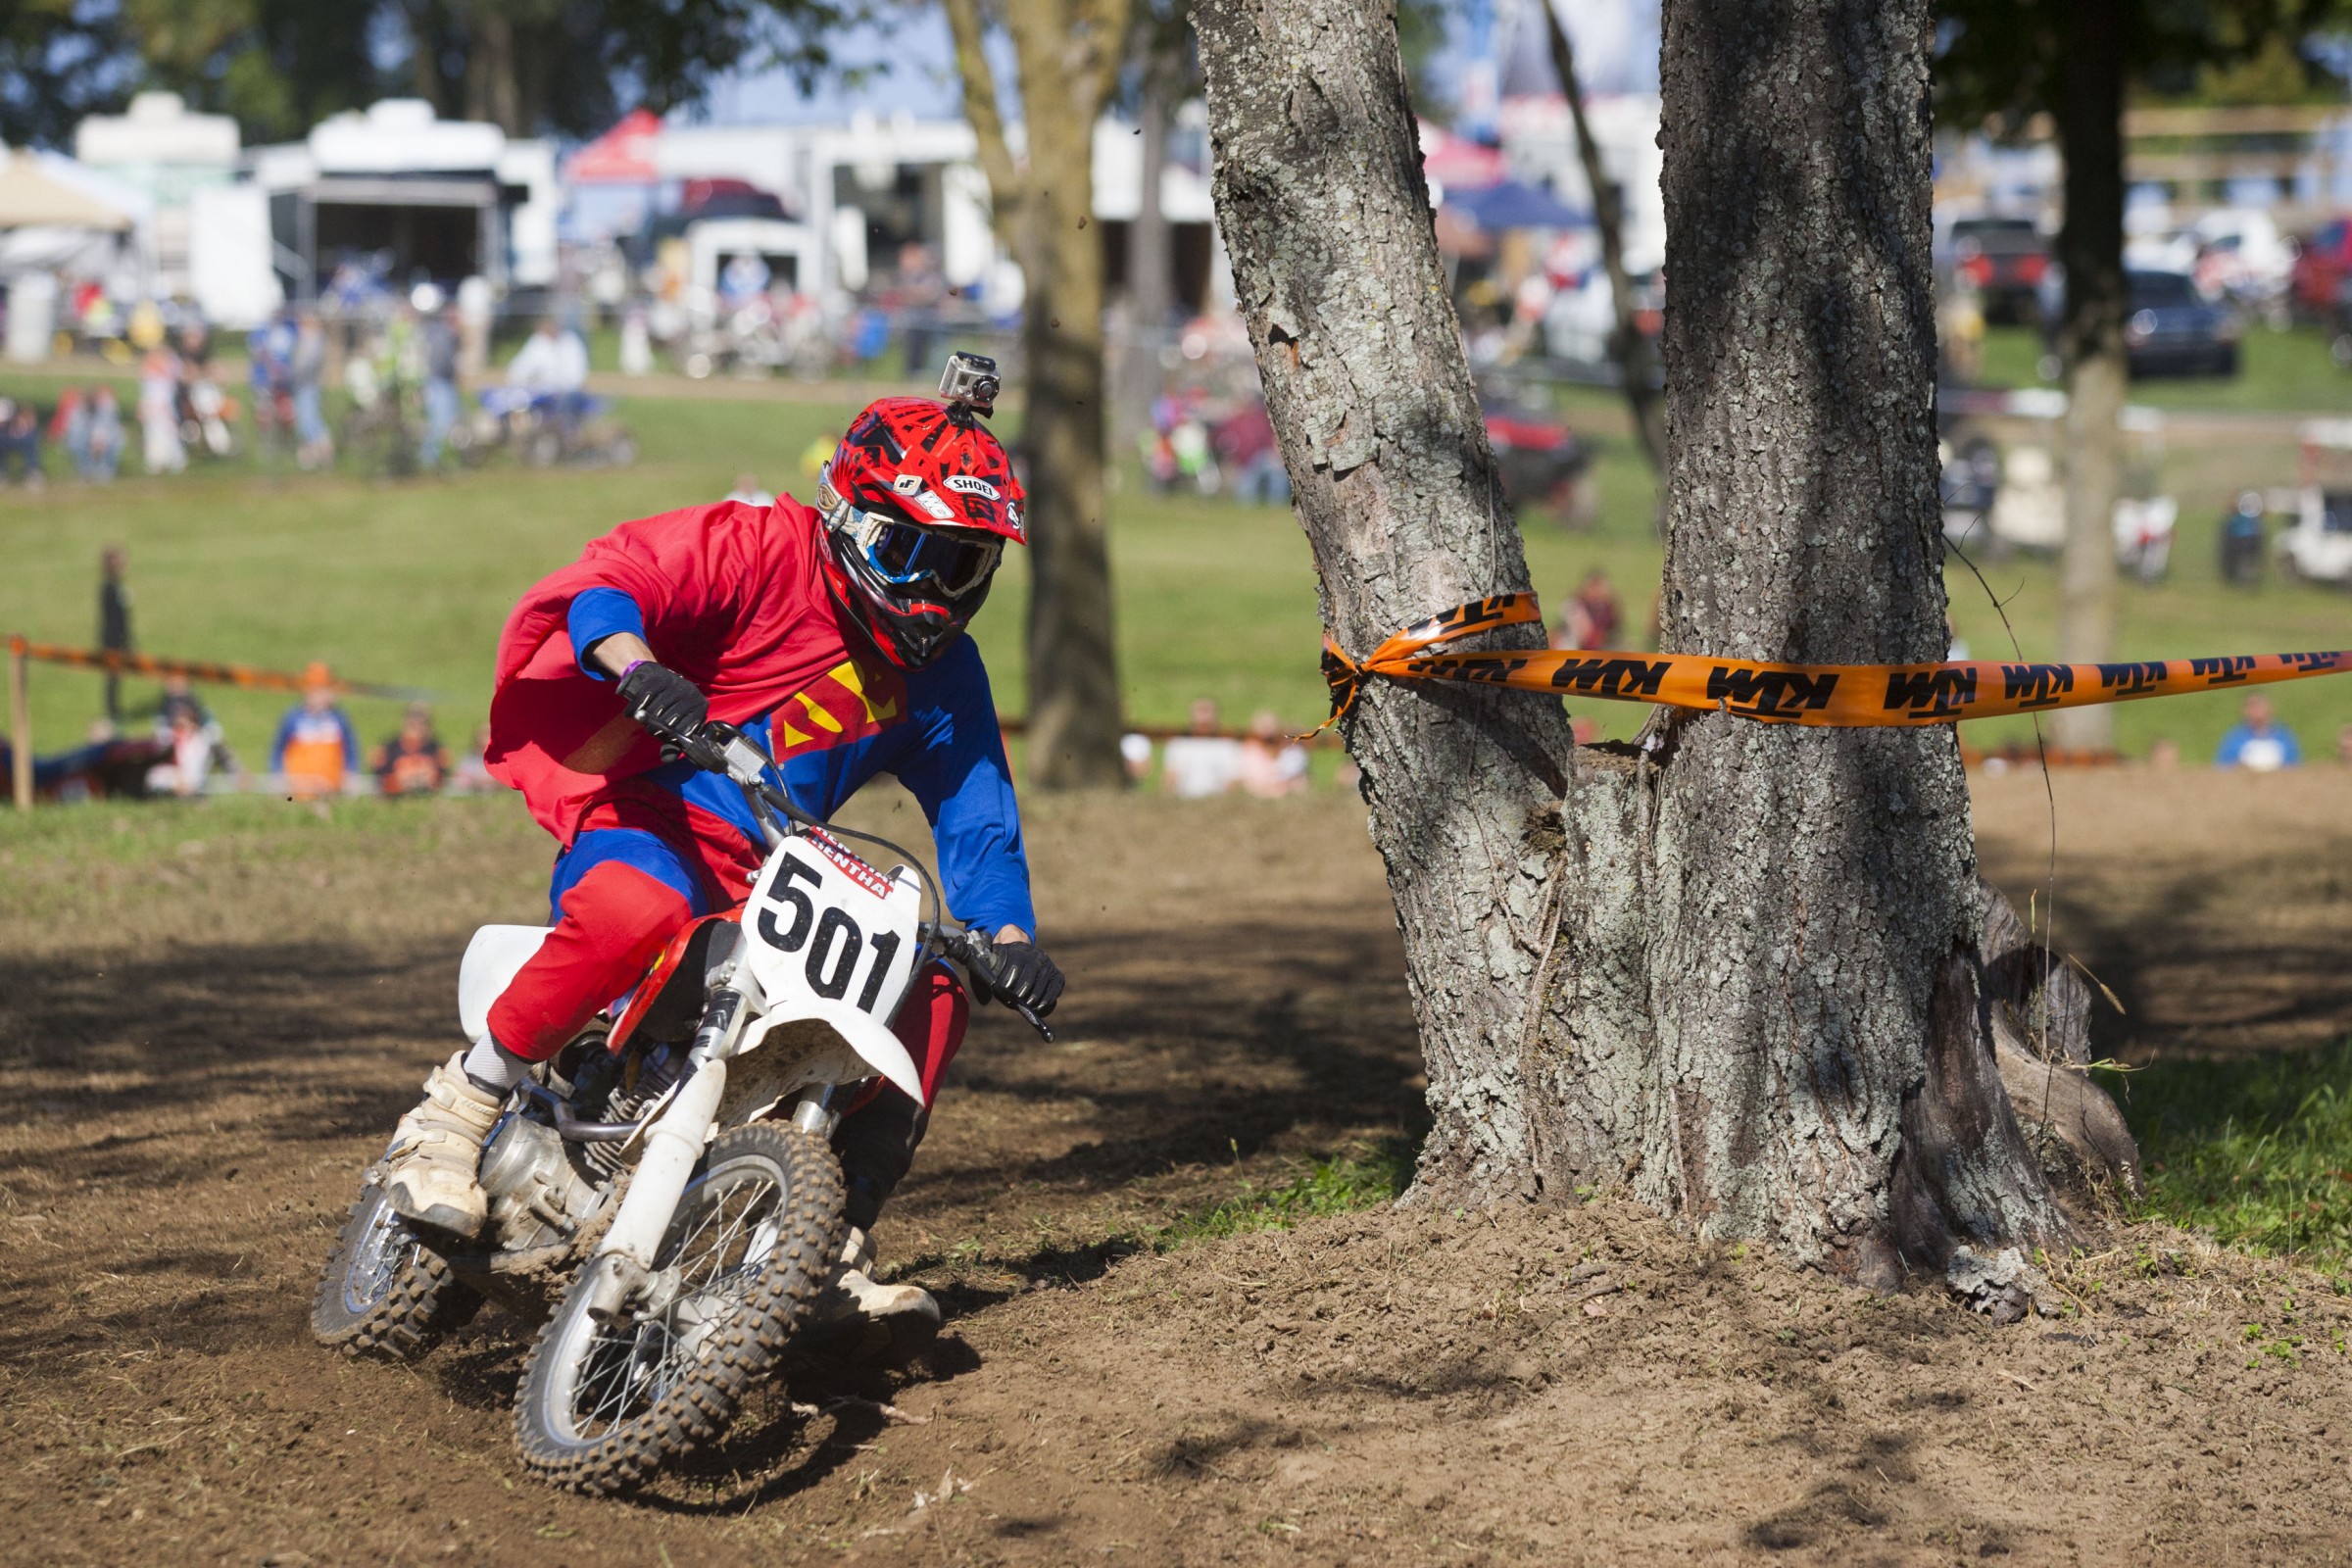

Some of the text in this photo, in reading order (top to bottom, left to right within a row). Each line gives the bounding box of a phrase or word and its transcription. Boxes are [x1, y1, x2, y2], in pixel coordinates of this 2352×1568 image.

[953, 479, 993, 496] SHOEI
[1551, 659, 1673, 701] KTM
[1706, 666, 1840, 718] KTM
[1884, 667, 1978, 718] KTM
[2001, 664, 2074, 708] KTM
[758, 852, 901, 1014] 501
